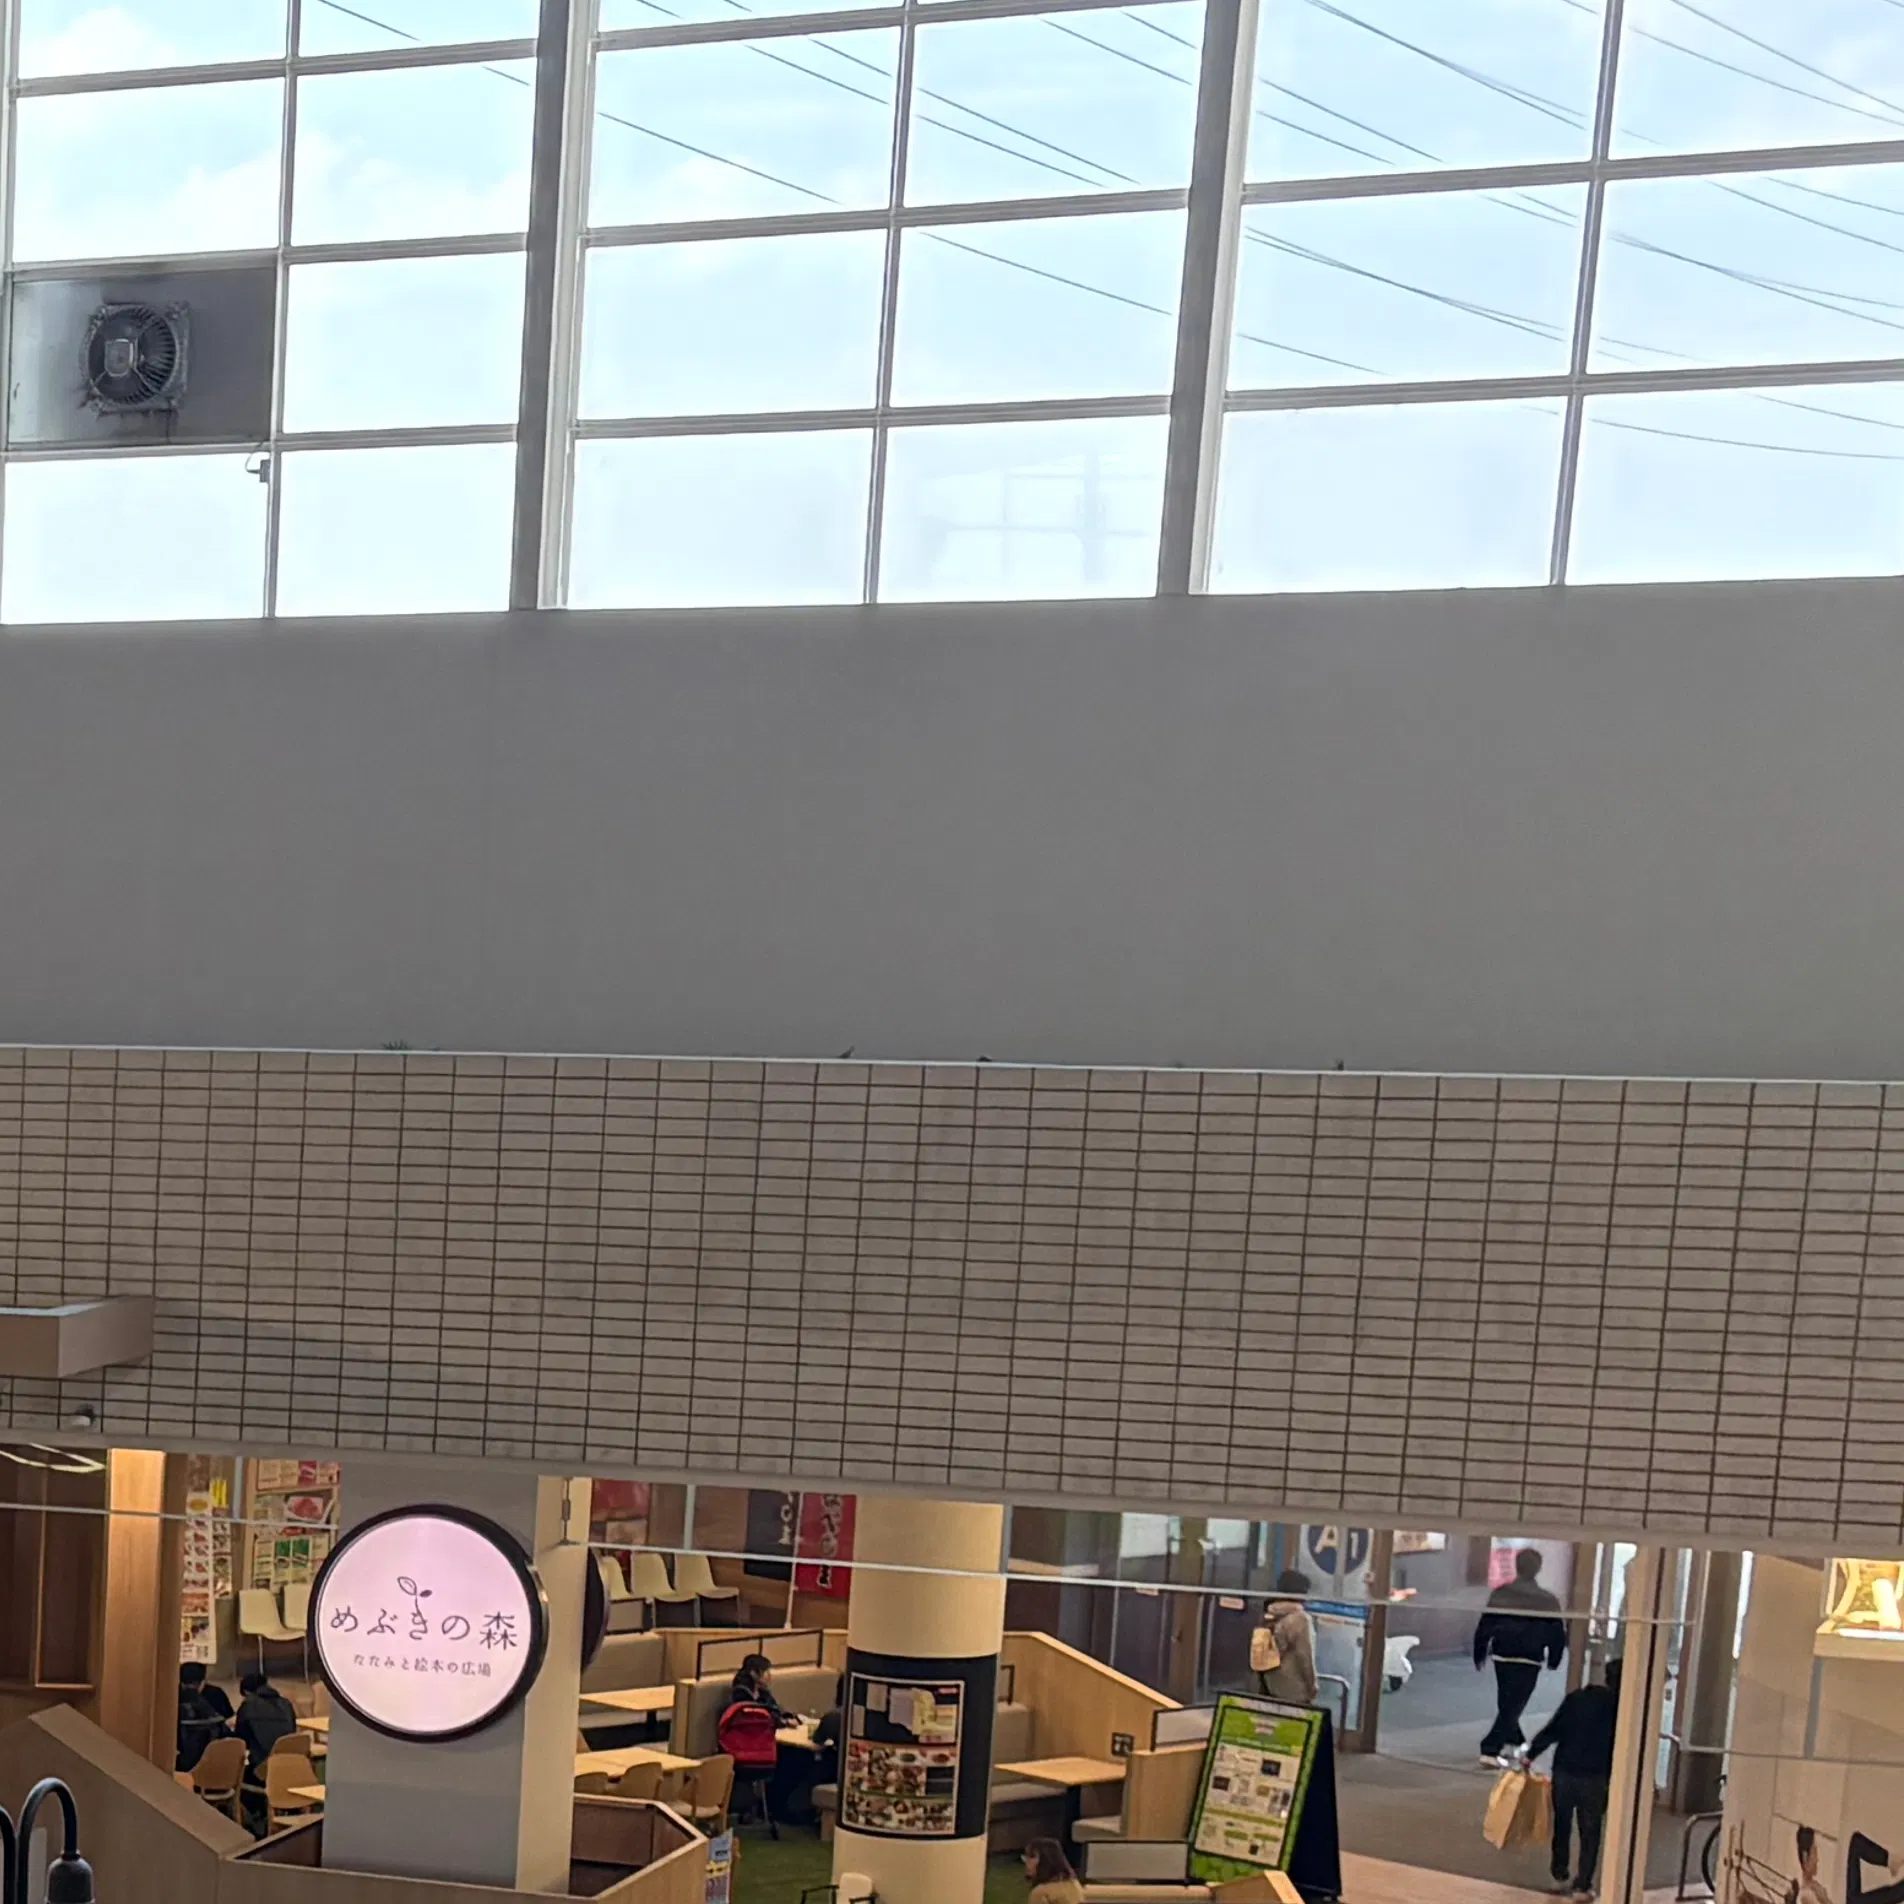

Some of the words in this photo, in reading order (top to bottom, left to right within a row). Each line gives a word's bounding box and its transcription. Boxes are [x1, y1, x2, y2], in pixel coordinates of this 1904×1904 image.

[329, 1602, 518, 1651] めぶきの森
